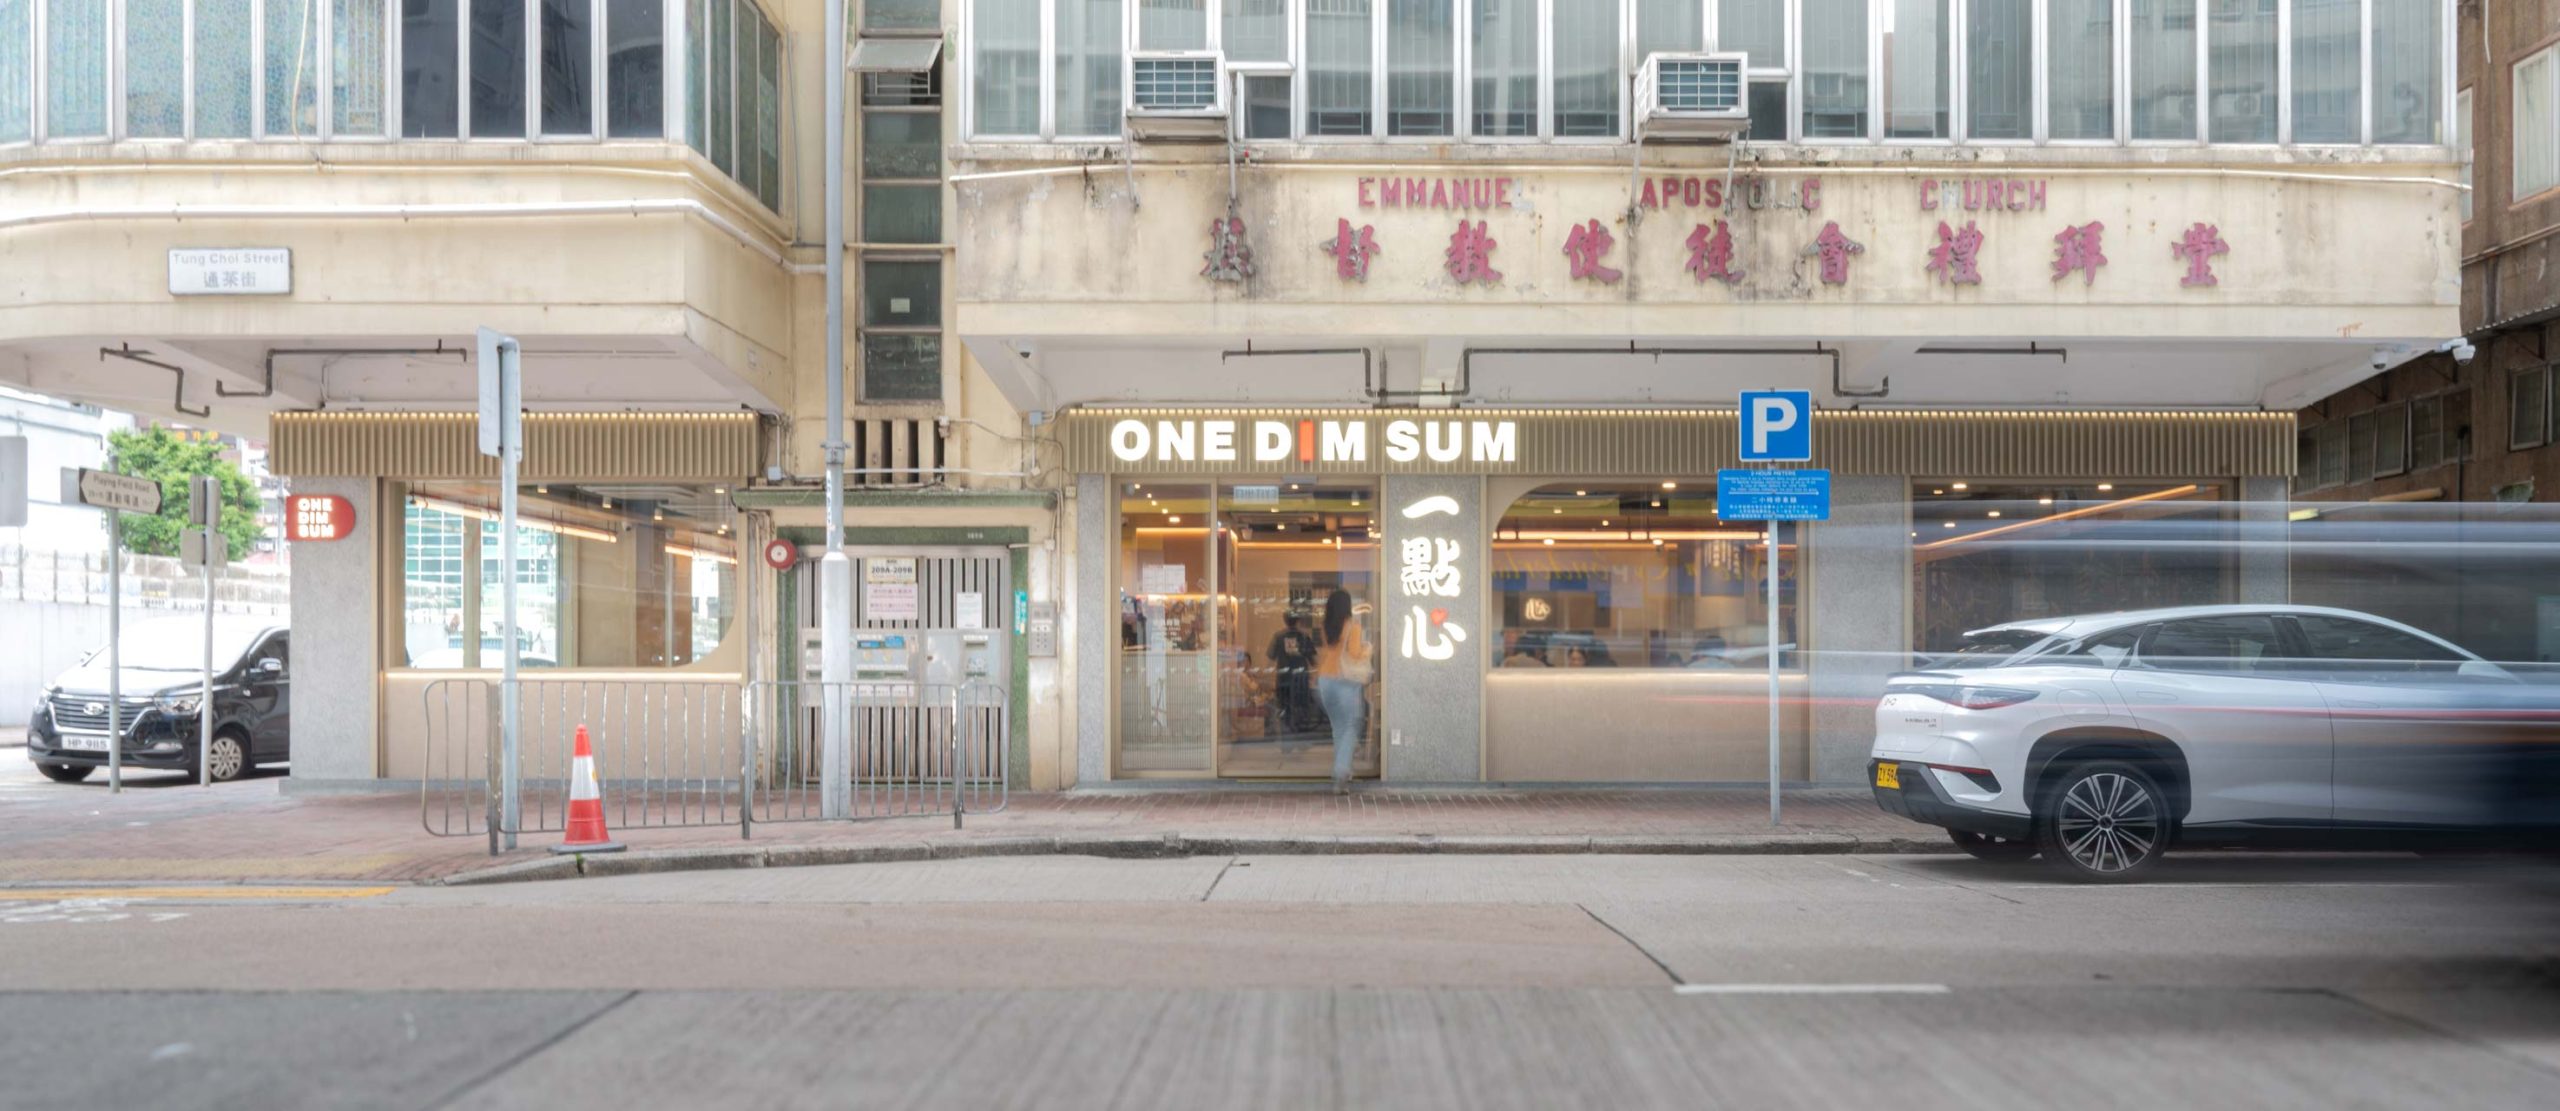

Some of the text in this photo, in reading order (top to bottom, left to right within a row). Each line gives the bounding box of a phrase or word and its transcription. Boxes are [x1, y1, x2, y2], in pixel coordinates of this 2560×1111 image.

[1920, 178, 2047, 210] CHURCH
[174, 253, 284, 266] Tung Choi Street
[204, 271, 256, 288] 通菜街
[1752, 398, 1797, 454] P
[1110, 419, 1516, 462] ONE DIM SUM
[297, 498, 332, 511] ONE
[298, 511, 329, 524] DIM
[298, 524, 334, 538] SUM
[1401, 495, 1466, 660] 一點心
